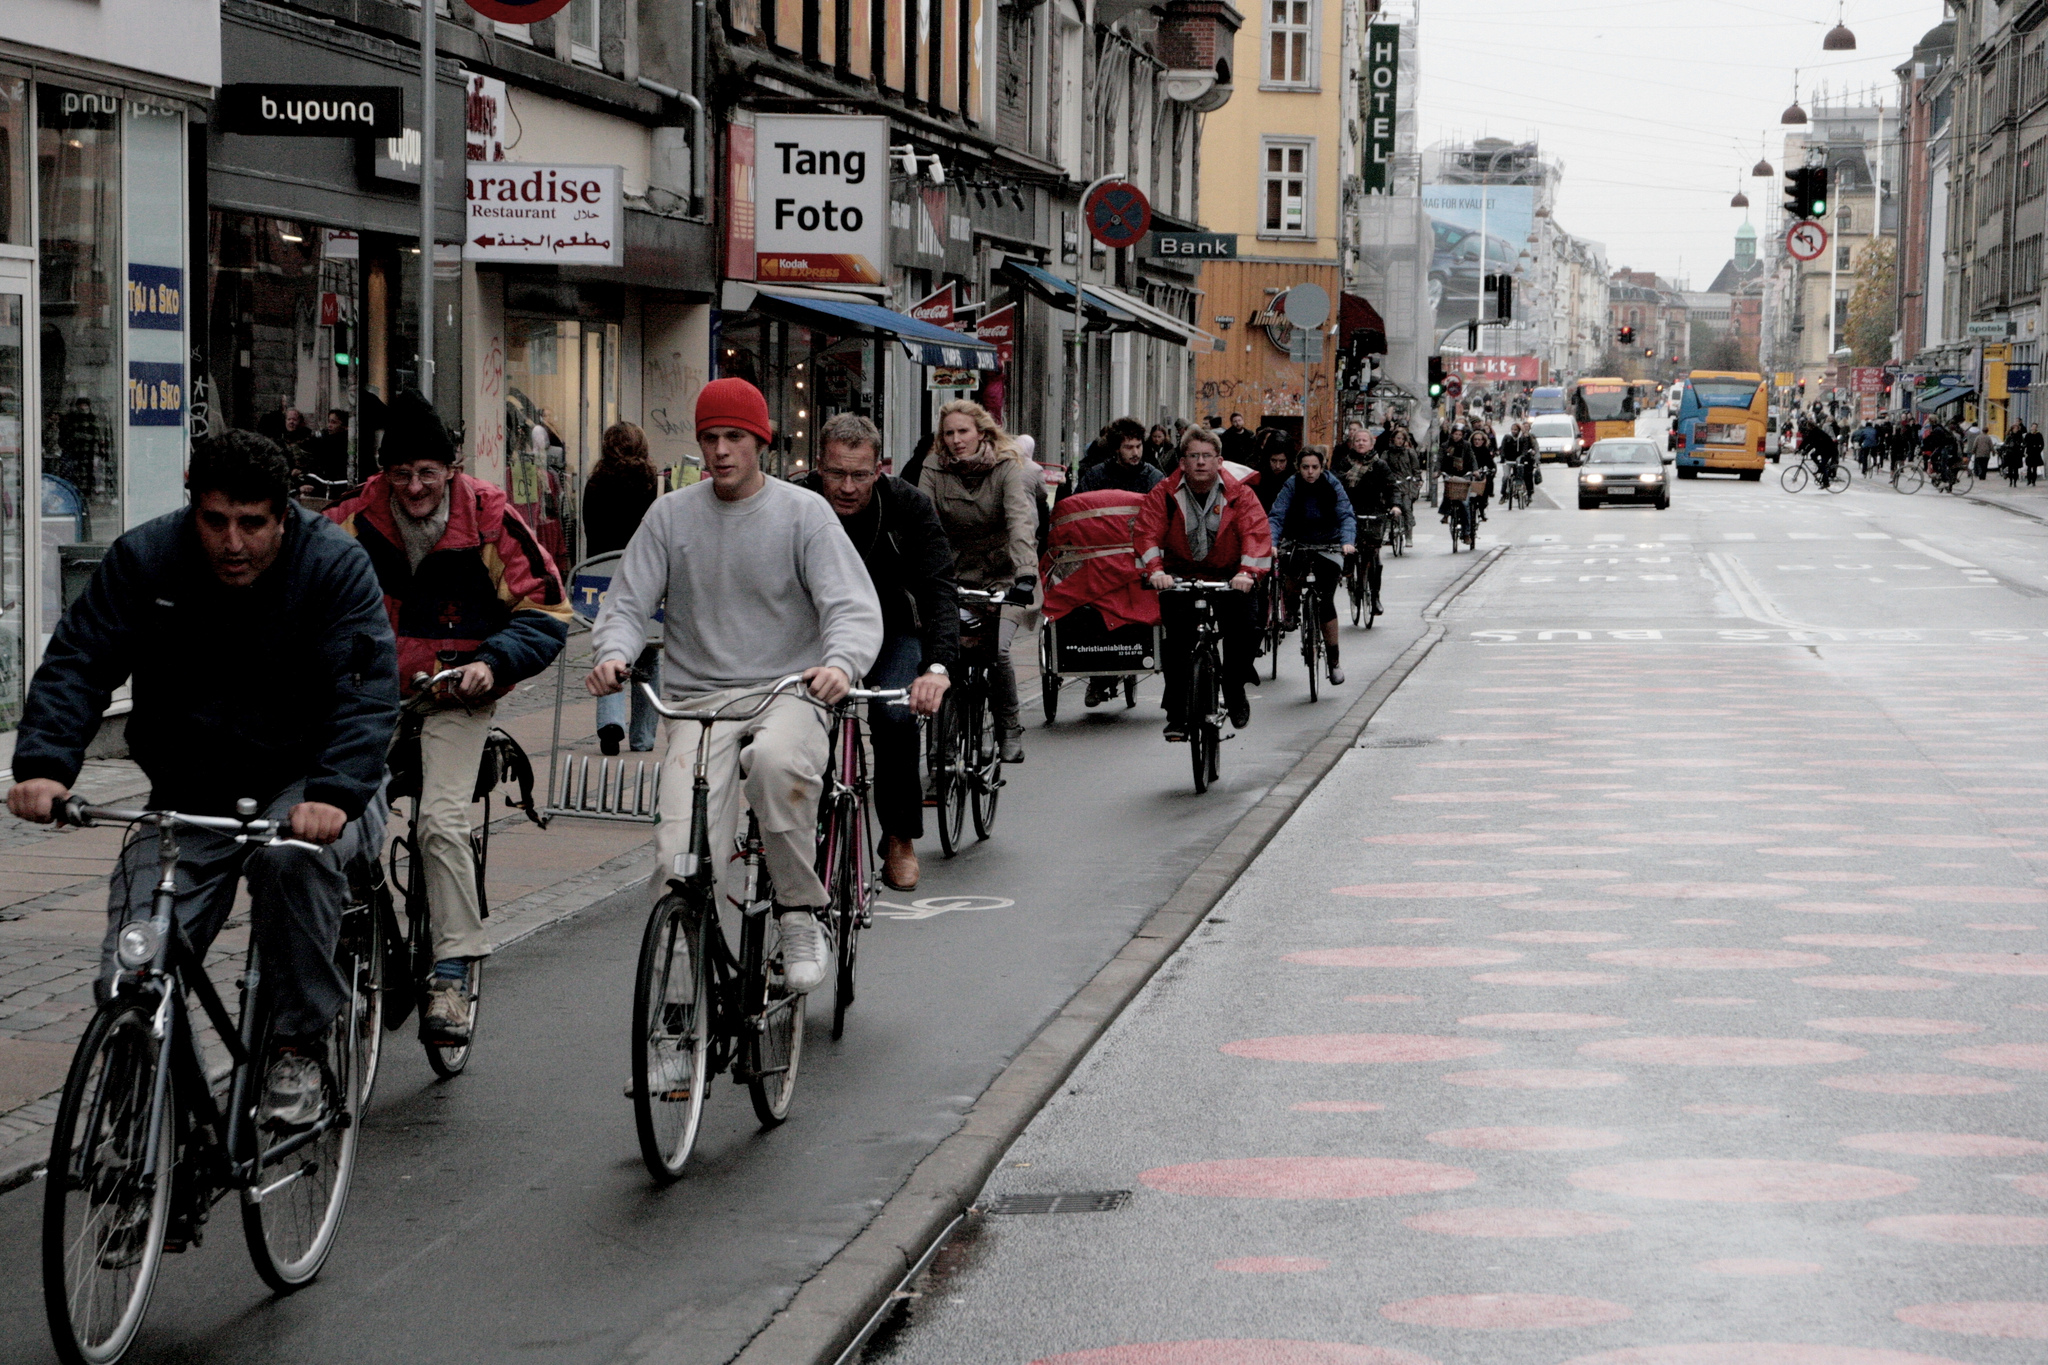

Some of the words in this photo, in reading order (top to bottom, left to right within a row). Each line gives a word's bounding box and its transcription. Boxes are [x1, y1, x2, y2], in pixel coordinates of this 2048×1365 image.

[261, 95, 374, 126] b.young
[1372, 41, 1392, 164] HOTEL
[774, 142, 865, 184] Tang
[466, 170, 601, 204] aradise
[472, 204, 557, 219] Restaurant
[1422, 198, 1440, 209] MAG
[1442, 198, 1457, 209] FOR
[1459, 198, 1496, 210] KVALIET
[573, 209, 600, 221] حلال
[775, 198, 864, 232] Foto
[497, 232, 551, 251] الجنة
[552, 230, 611, 254] مطعم
[1160, 237, 1228, 255] Bank
[779, 258, 808, 269] Kodak
[790, 267, 840, 278] EXPRESS
[1969, 323, 2004, 333] apotek
[1077, 644, 1143, 653] christianiabikes.dk
